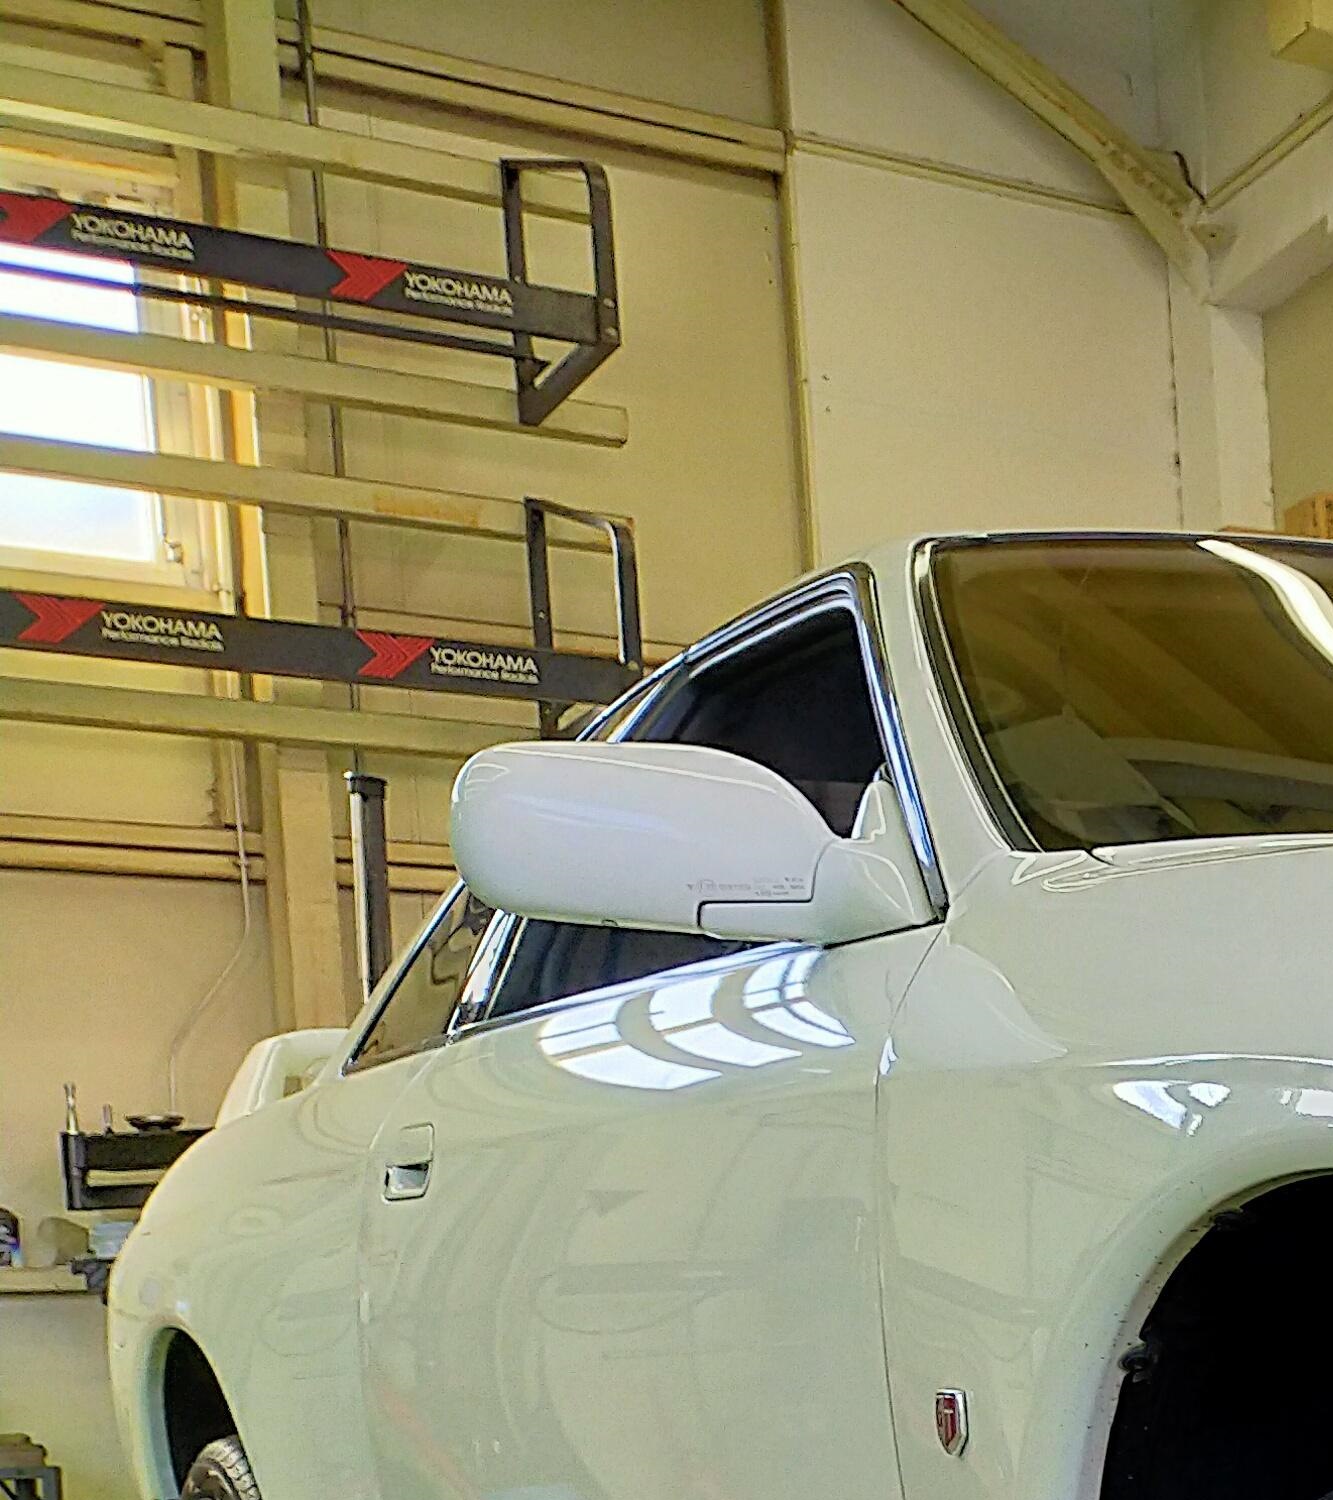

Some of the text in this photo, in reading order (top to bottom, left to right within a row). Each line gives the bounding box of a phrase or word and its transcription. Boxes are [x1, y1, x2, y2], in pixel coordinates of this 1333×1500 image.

[71, 213, 195, 251] YOKOHAMA
[404, 271, 513, 307] YOKOHAMA
[101, 611, 224, 641] YOKOHAMA
[430, 646, 539, 675] YOKOHAMA
